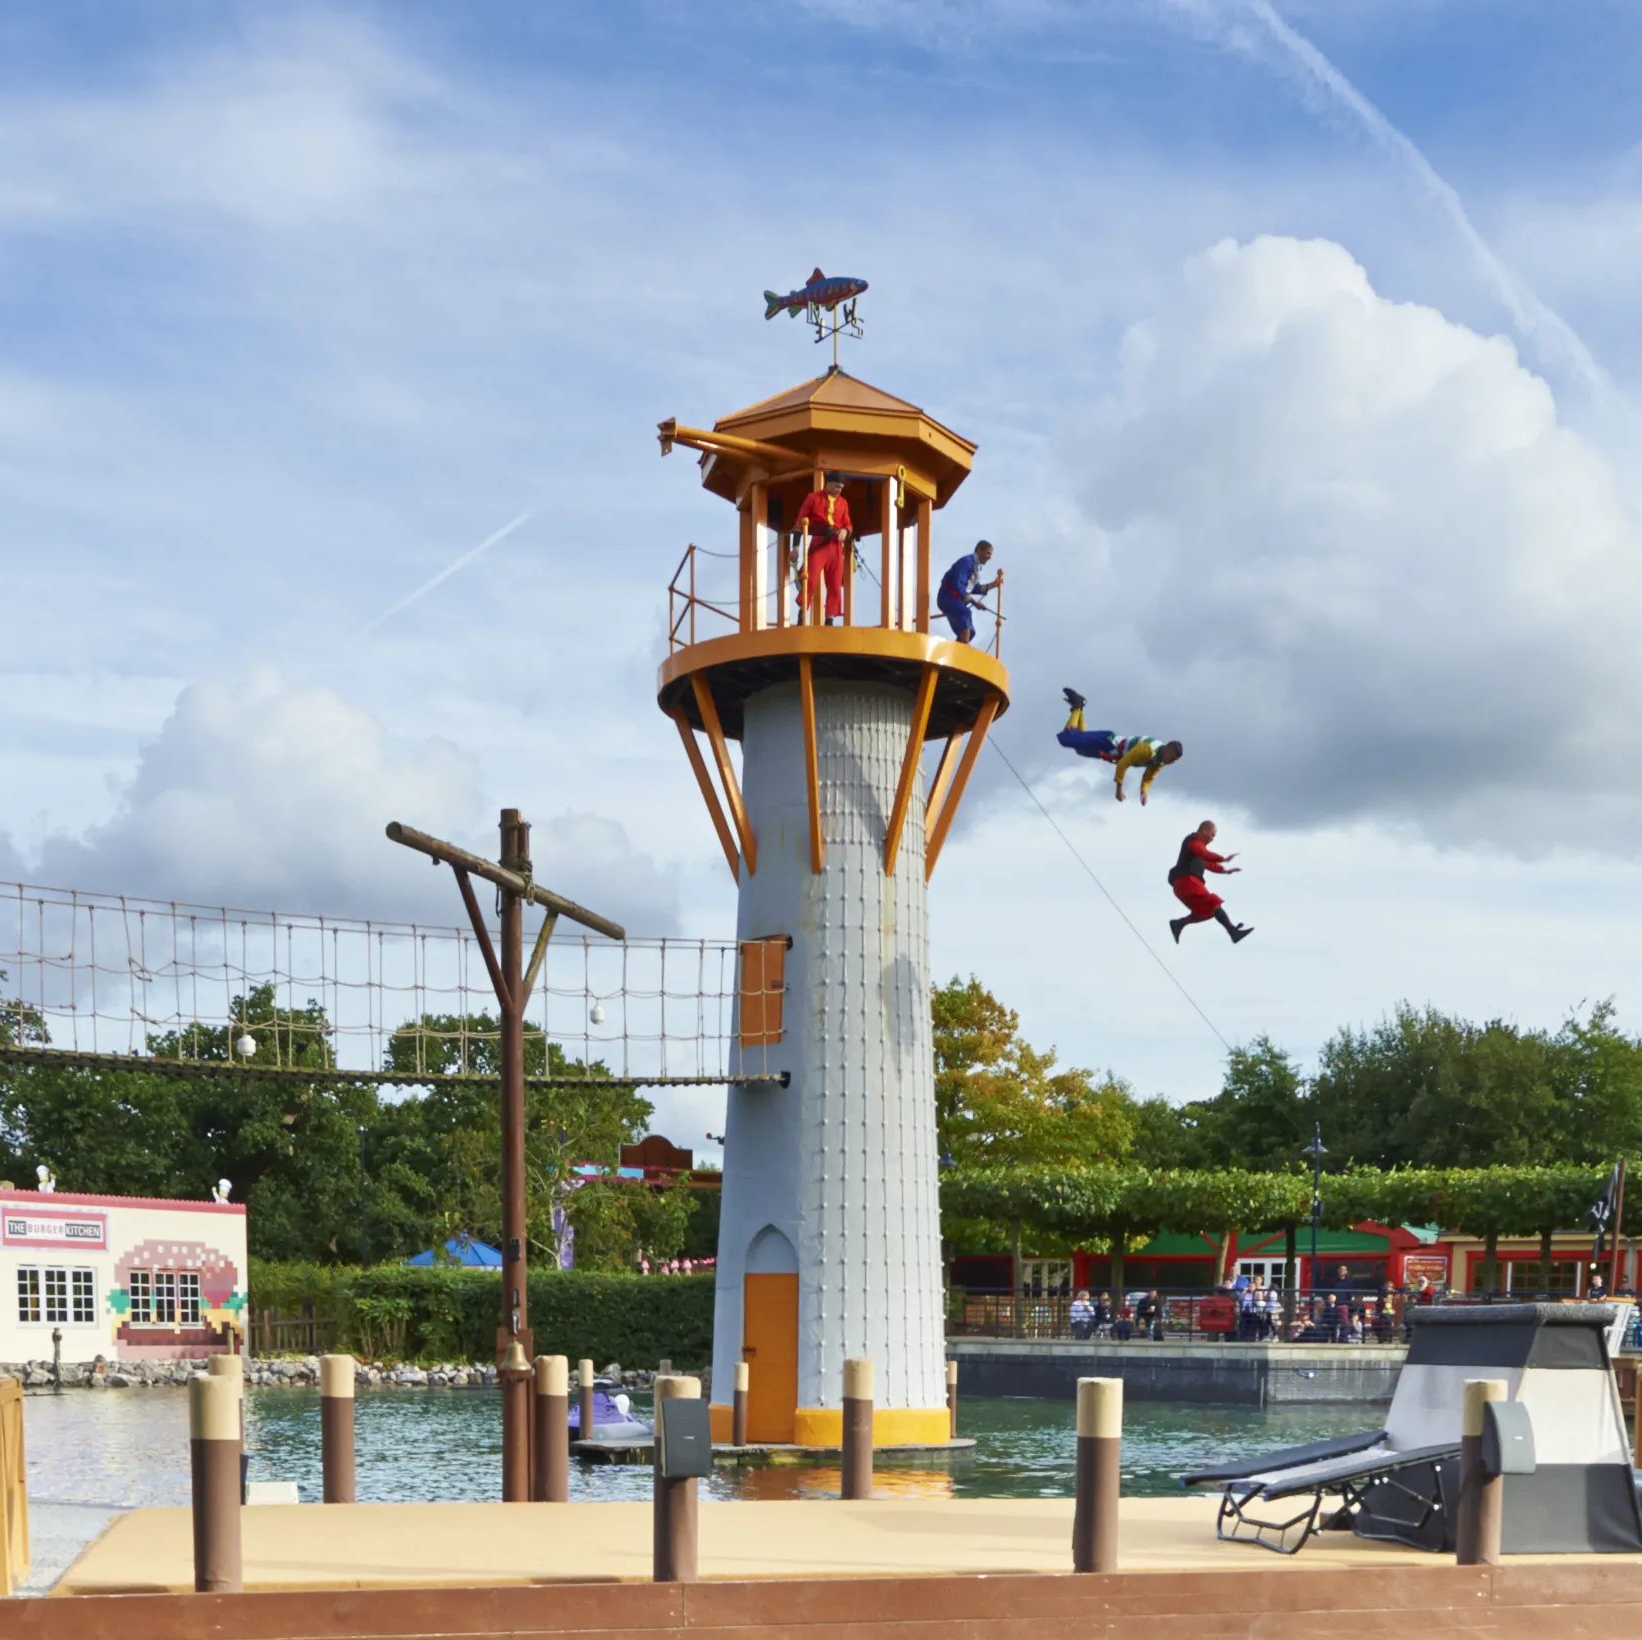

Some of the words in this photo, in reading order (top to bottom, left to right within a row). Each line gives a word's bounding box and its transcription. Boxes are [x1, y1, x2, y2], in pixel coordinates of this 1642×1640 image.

[9, 1222, 26, 1234] THE
[27, 1223, 64, 1235] BURGER
[65, 1225, 100, 1237] KITCHEN
